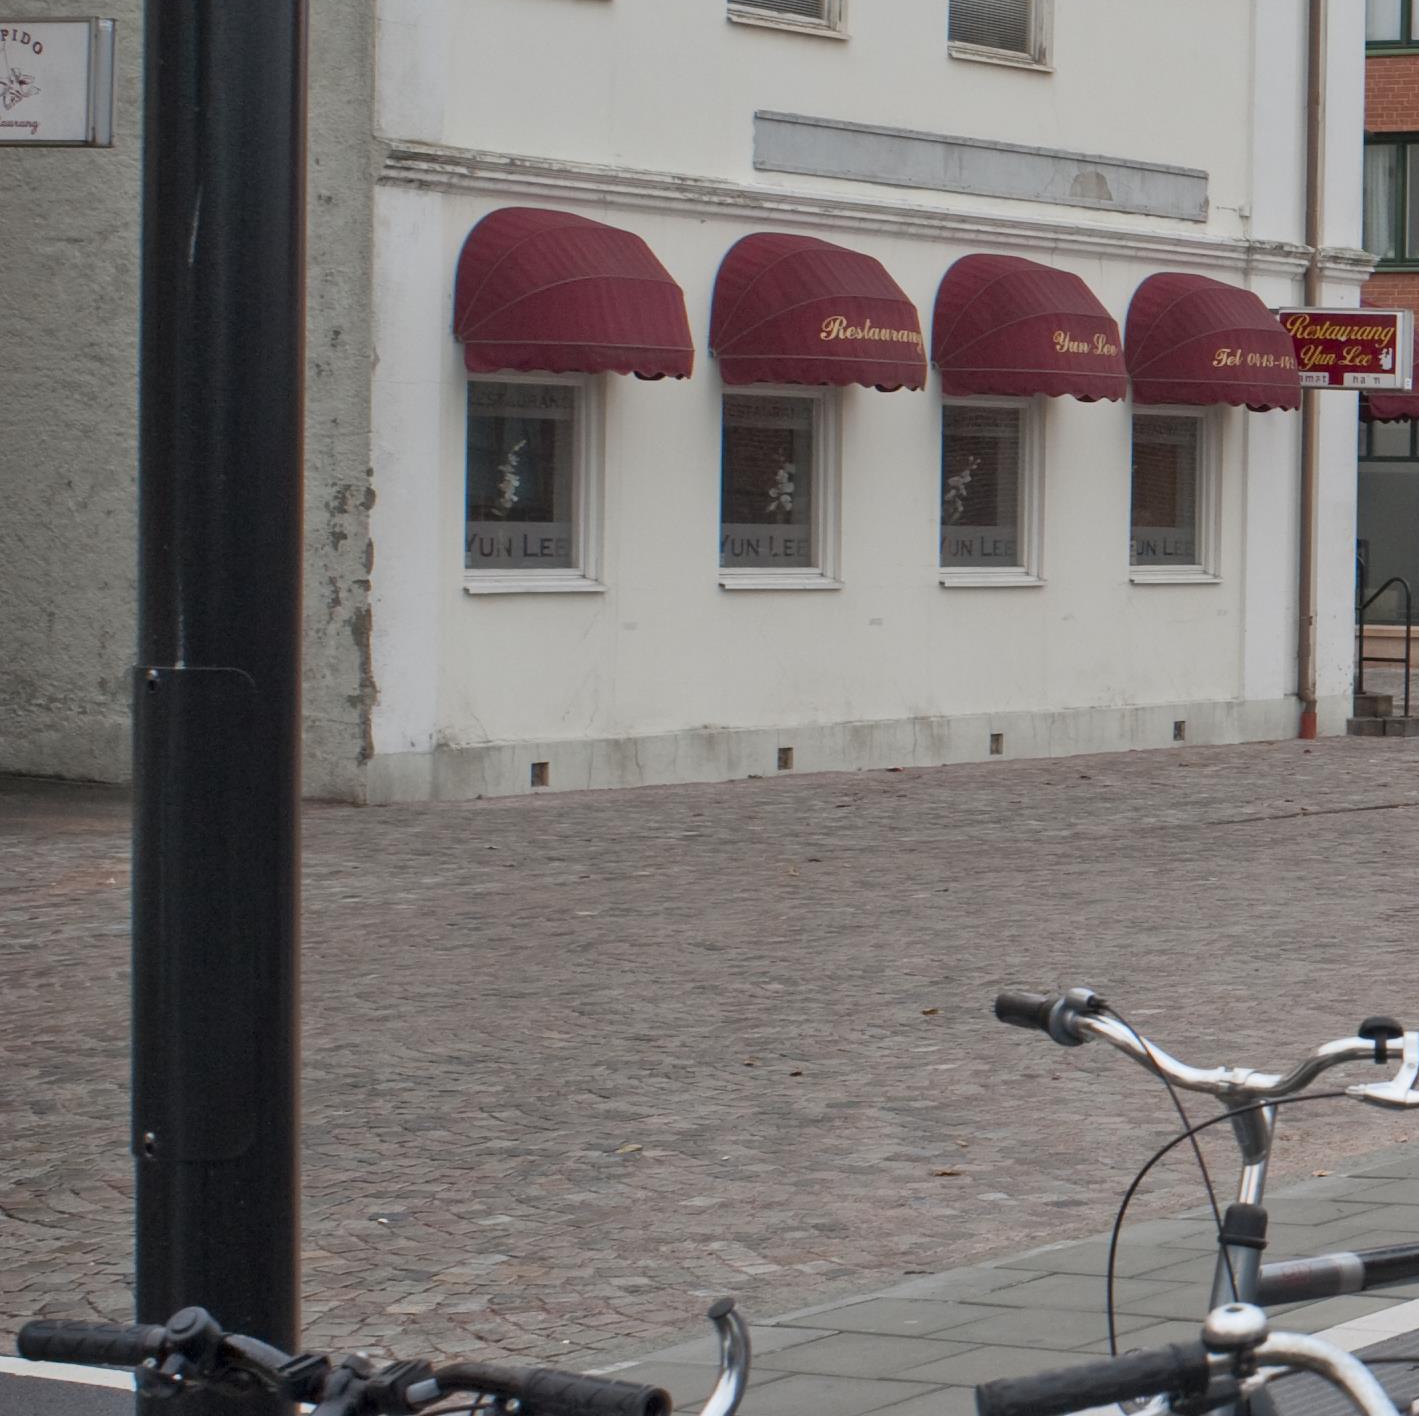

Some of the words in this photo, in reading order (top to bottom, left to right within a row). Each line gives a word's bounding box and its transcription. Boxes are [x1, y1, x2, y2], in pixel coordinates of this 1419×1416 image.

[820, 315, 922, 354] Restaurang
[1053, 330, 1090, 353] Yun
[1093, 333, 1119, 356] Lee
[1286, 314, 1395, 347] Restaurang
[1212, 348, 1243, 367] Tel
[1299, 345, 1337, 370] Yun
[1339, 346, 1374, 366] Lee
[523, 533, 570, 558] LEE
[769, 535, 809, 557] LEE
[981, 536, 1017, 557] LEE
